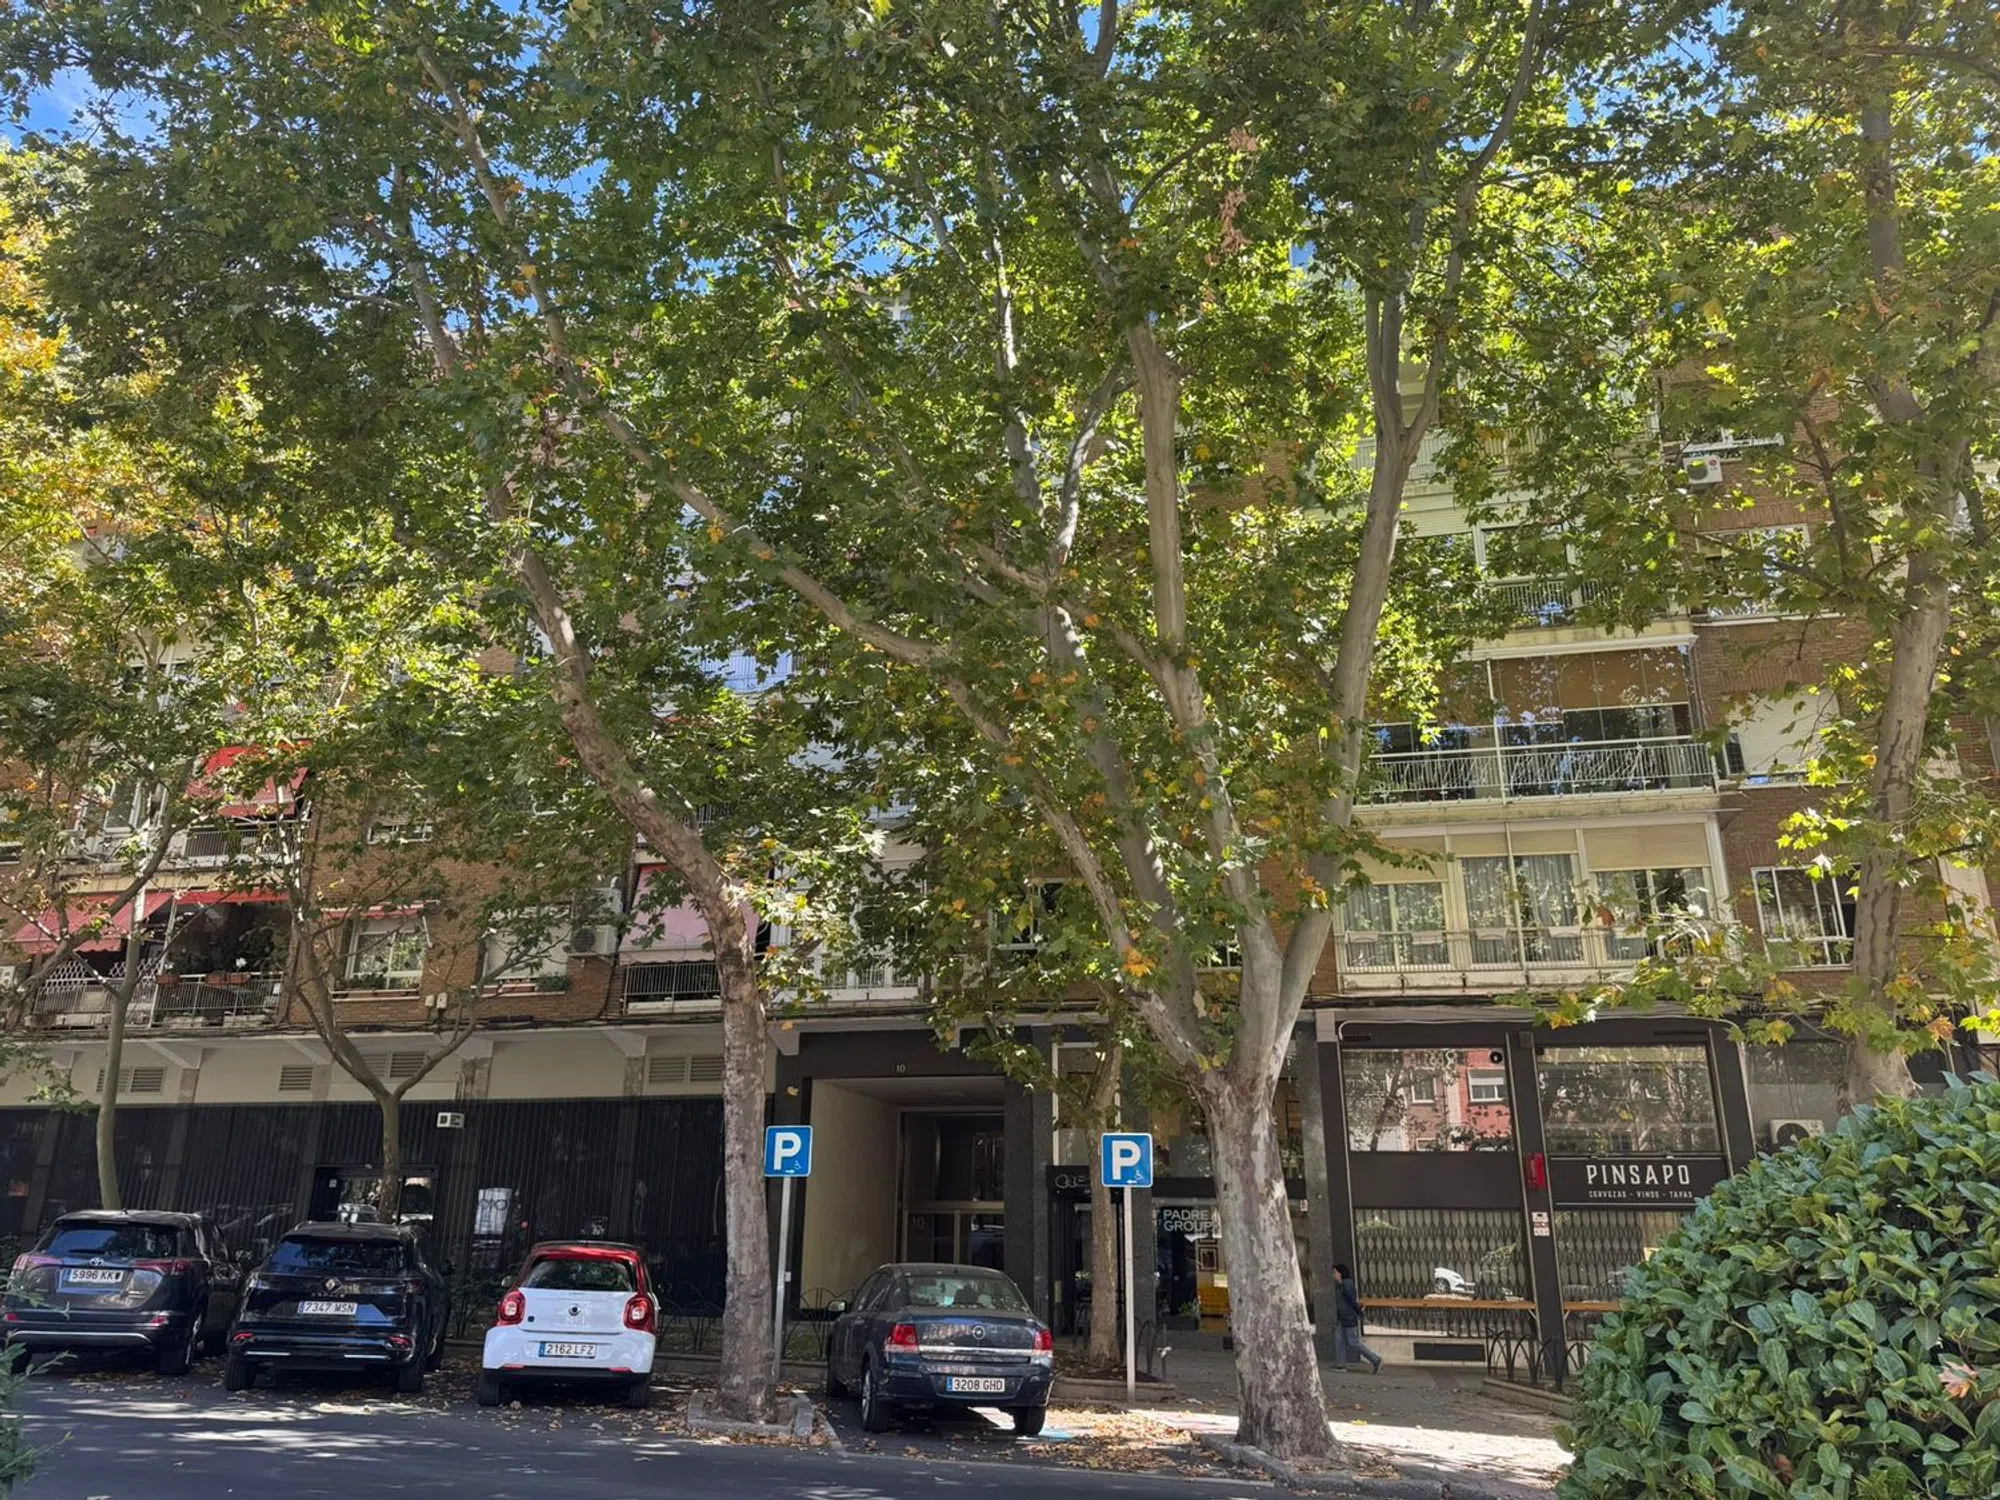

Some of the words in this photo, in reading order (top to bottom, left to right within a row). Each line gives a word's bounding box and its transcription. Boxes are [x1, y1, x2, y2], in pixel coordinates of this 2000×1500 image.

[774, 1132, 802, 1170] P
[1112, 1140, 1141, 1180] P
[1586, 1165, 1690, 1185] PINSAPO
[1588, 1190, 1627, 1198] CERVEZAS
[1636, 1190, 1660, 1198] VINOS
[1163, 1209, 1209, 1220] PADRE
[1163, 1220, 1212, 1232] GROUP
[73, 1270, 99, 1279] 5996
[100, 1271, 121, 1280] KK
[305, 1302, 332, 1312] 7347
[333, 1303, 355, 1313] MSN
[546, 1344, 572, 1354] 2162
[574, 1345, 594, 1355] LFZ
[954, 1379, 980, 1390] 3208
[982, 1380, 1003, 1391] GHD
